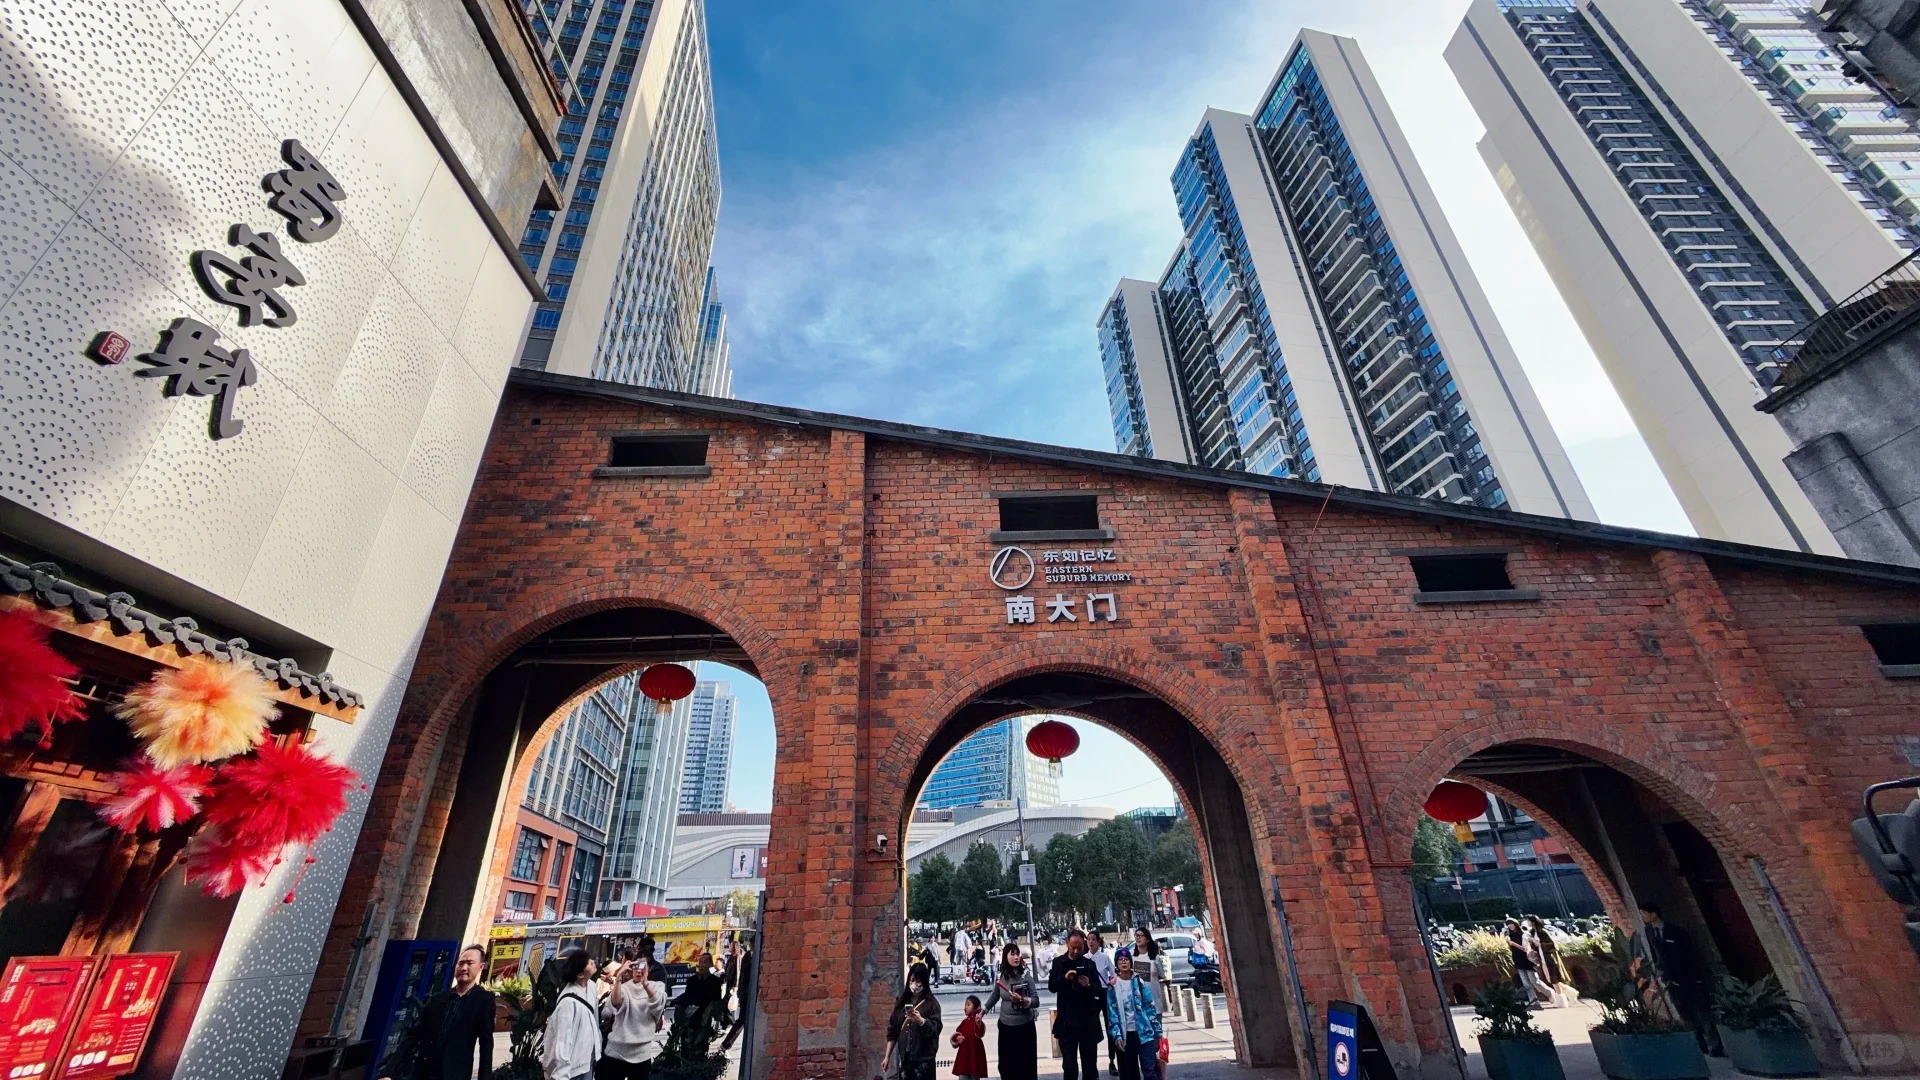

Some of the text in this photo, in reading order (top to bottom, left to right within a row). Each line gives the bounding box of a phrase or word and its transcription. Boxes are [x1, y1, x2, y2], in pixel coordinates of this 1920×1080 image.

[1043, 549, 1116, 563] 东郊记忆
[1045, 566, 1093, 574] EASTERN
[1046, 573, 1132, 583] SUBURB MEMORY
[1005, 592, 1118, 624] 南大门
[495, 946, 519, 956] 豆干
